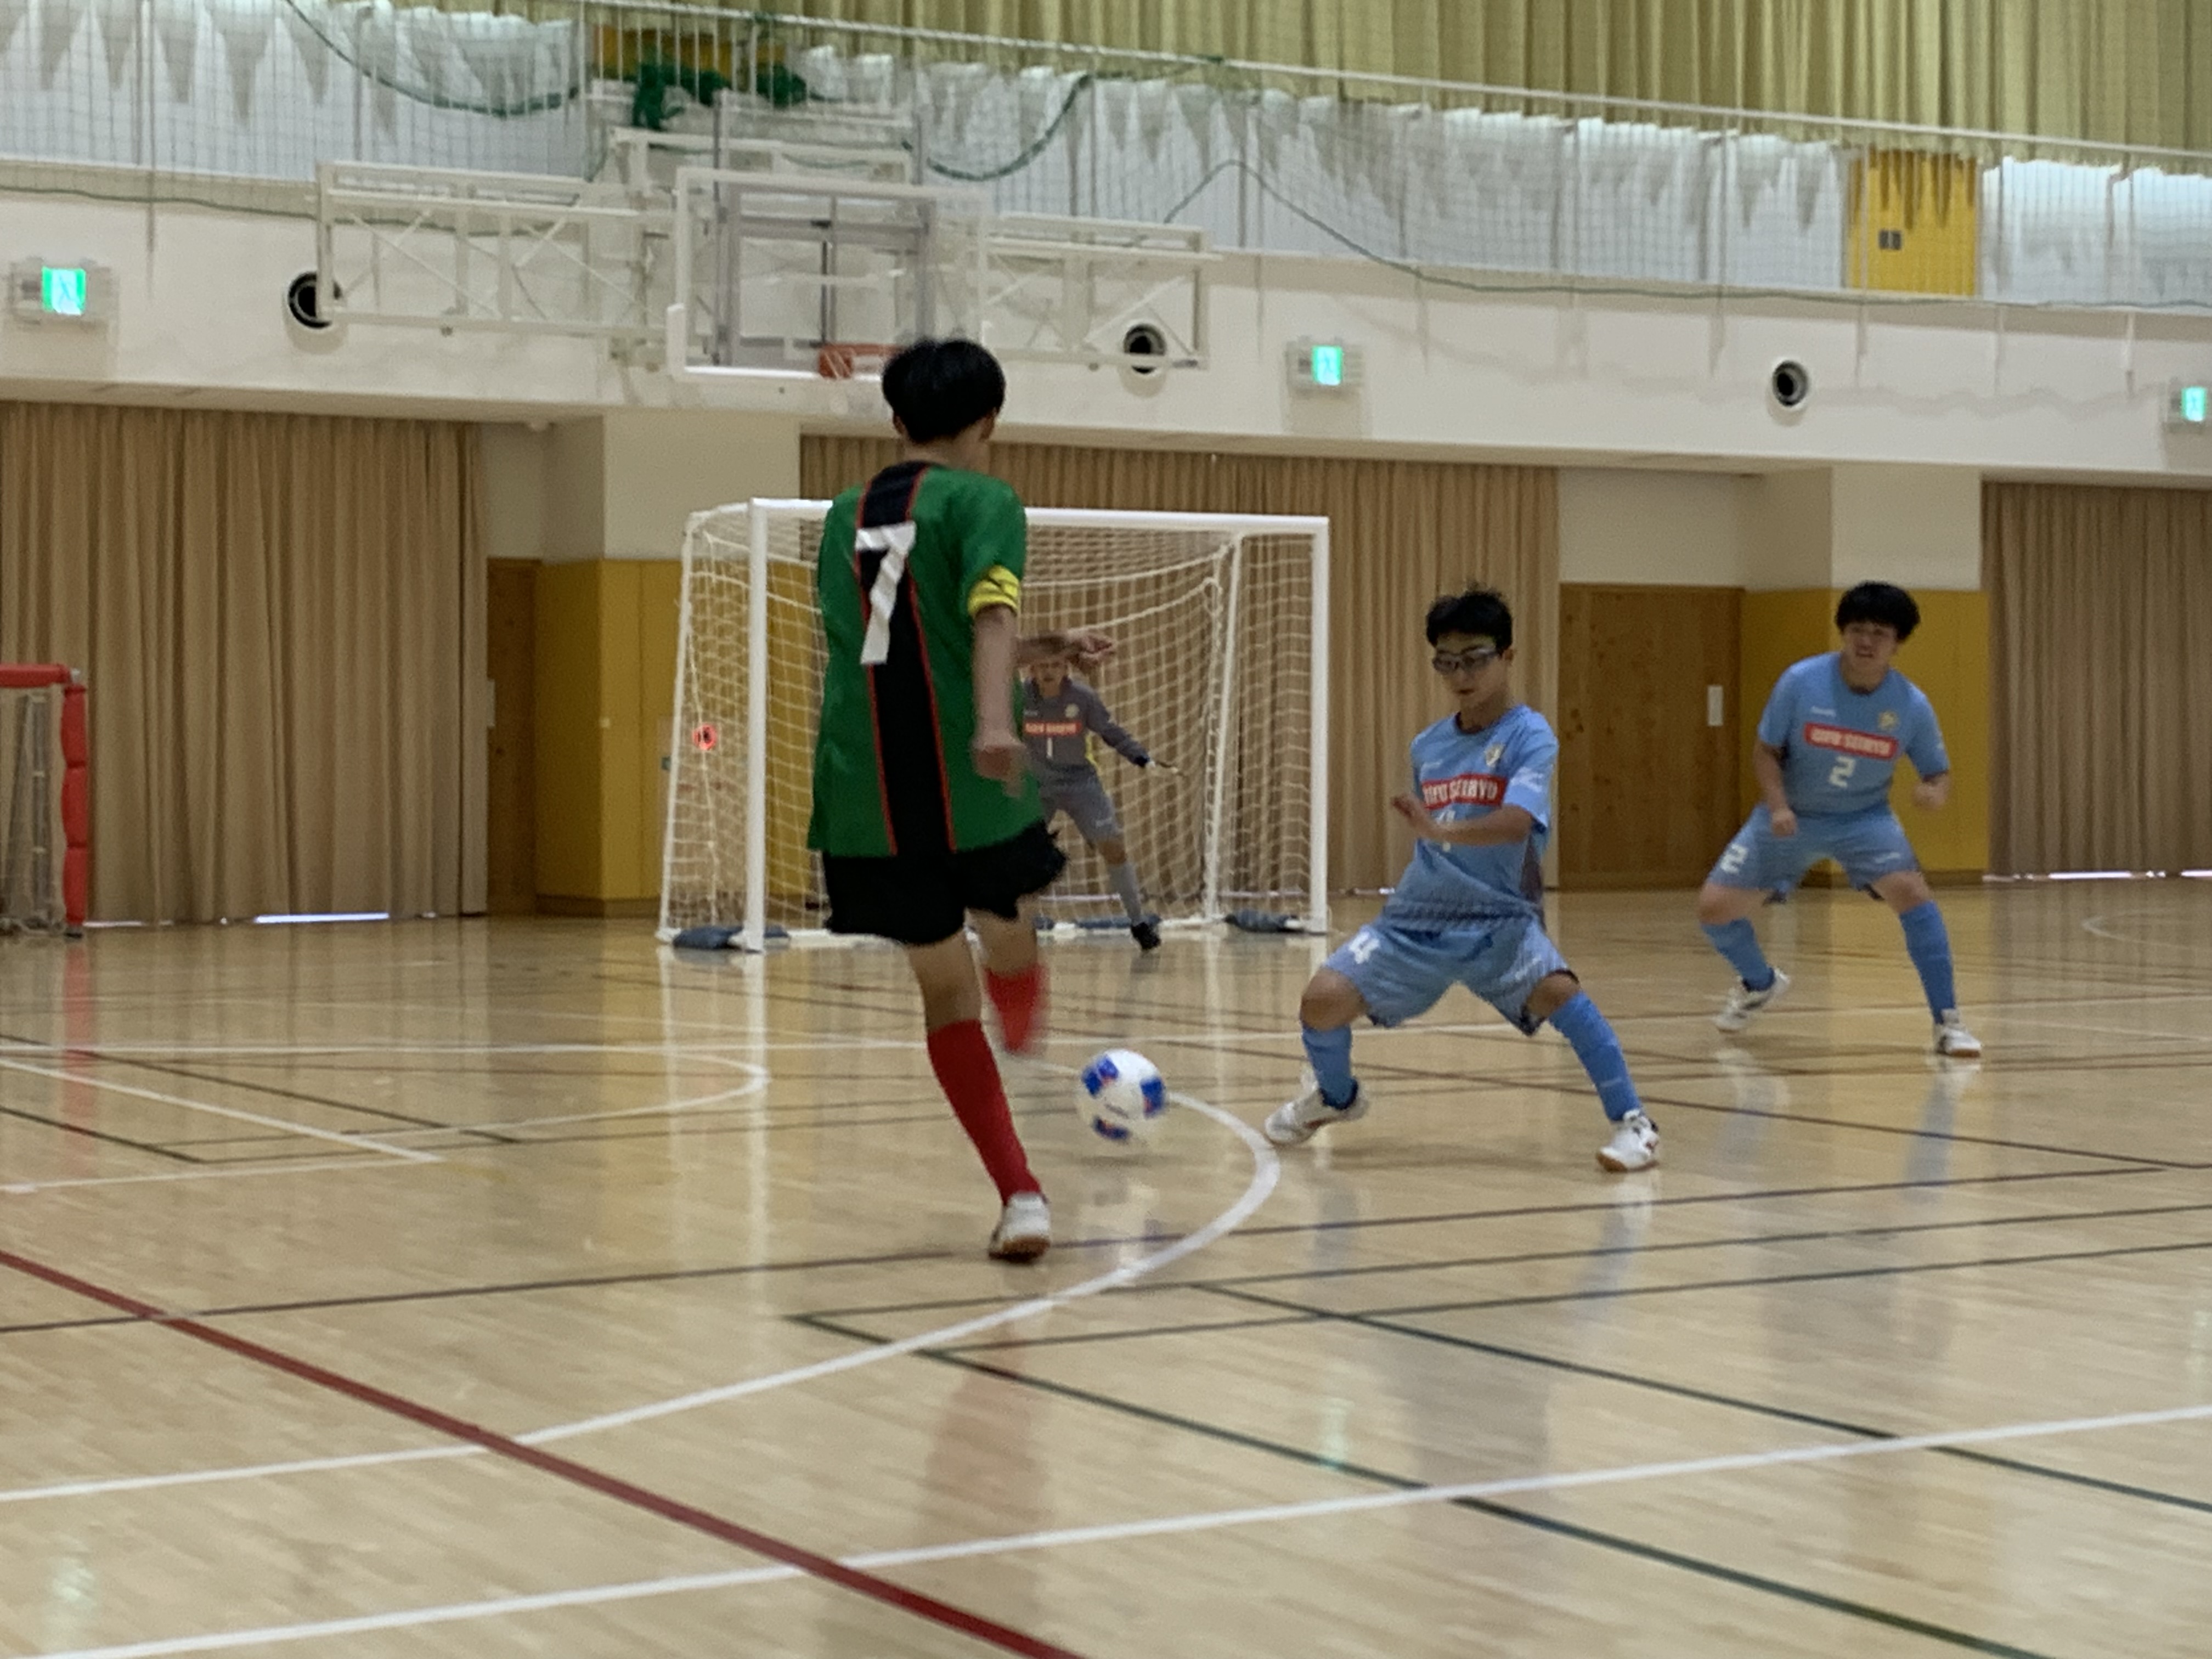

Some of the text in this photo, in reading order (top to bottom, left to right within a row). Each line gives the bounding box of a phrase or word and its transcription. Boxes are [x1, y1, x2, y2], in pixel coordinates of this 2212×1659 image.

[855, 521, 916, 664] 7
[1046, 738, 1053, 758] 1
[1829, 756, 1856, 788] 2
[1719, 844, 1748, 874] 2
[1349, 931, 1380, 964] 4
